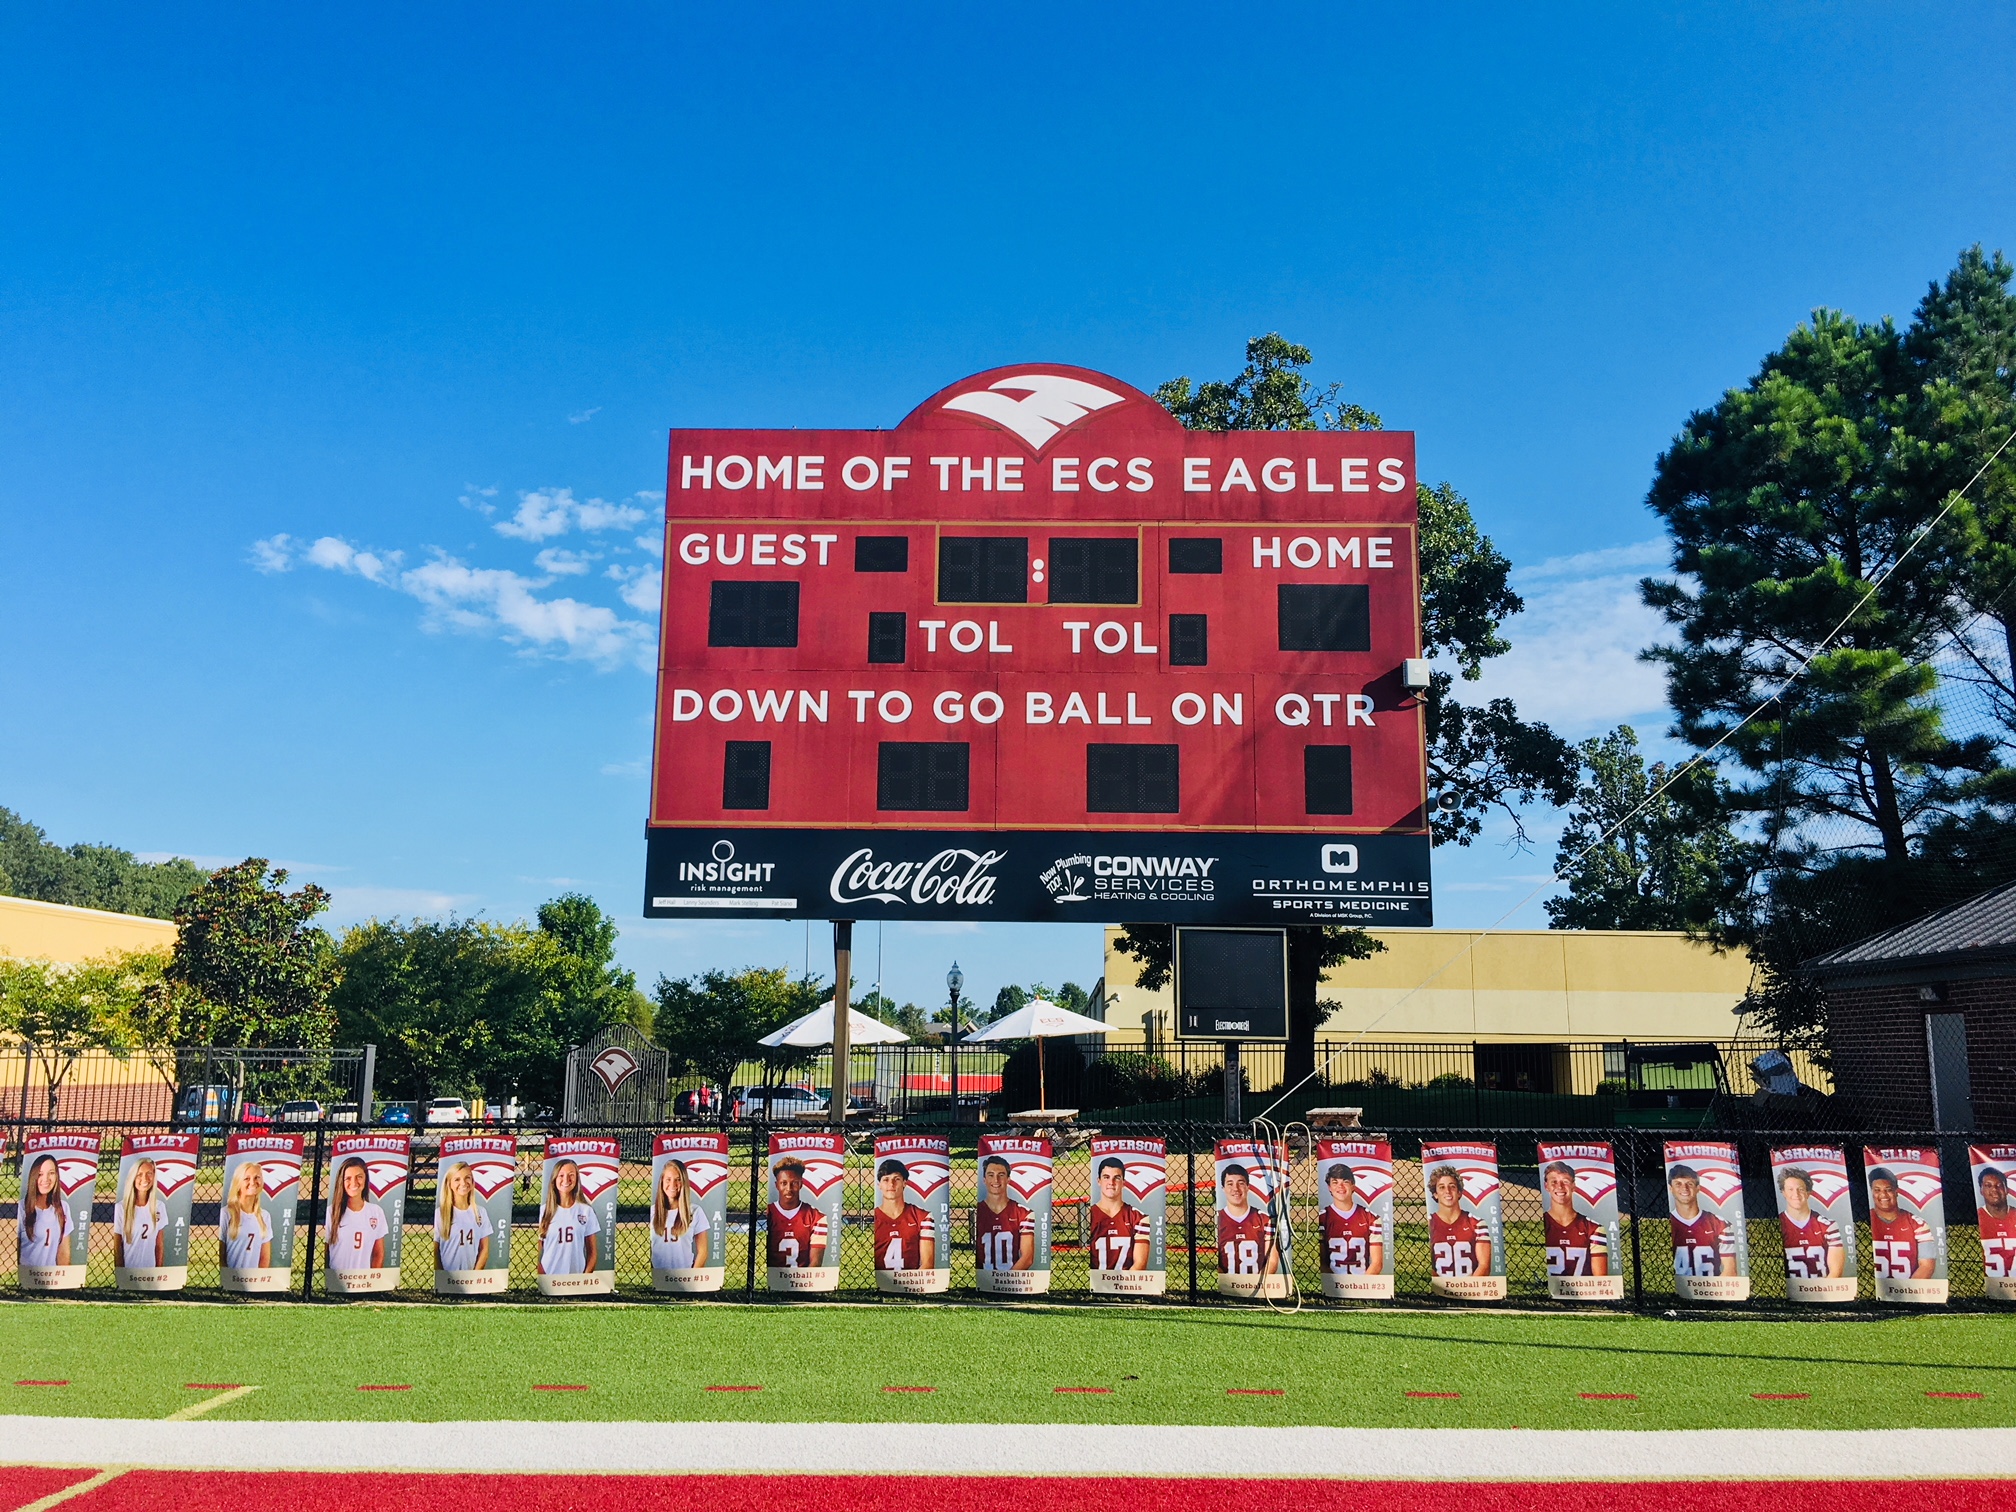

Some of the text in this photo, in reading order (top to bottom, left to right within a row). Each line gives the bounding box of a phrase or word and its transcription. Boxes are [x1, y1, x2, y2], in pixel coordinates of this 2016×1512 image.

[681, 454, 1406, 493] HOME OF THE ECS EAGLES
[679, 533, 838, 566] GUEST
[1252, 537, 1394, 569] HOME
[918, 620, 1013, 653] TOL
[1063, 621, 1158, 654] TOL
[672, 689, 1376, 727] DOWN TO GO BALL ON QTR
[679, 862, 775, 881] INSIGHT
[1039, 853, 1091, 884] Now Plumbing
[1094, 856, 1214, 877] CONWAY
[830, 848, 1008, 905] Coca-Cola
[1094, 878, 1214, 891] SERVICES
[691, 883, 762, 894] risk management
[1253, 880, 1429, 892] ORTHOMEMPHIS
[1273, 900, 1409, 910] SPORTS MEDICINE
[28, 1138, 98, 1150] CARRUTH
[132, 1136, 189, 1148] ELLZEY
[238, 1138, 294, 1150] ROGERS
[337, 1138, 406, 1151] COOLIDGE
[445, 1138, 513, 1152] SHORTEN
[549, 1142, 616, 1154] SOMOGYI
[662, 1137, 718, 1151] ROOKER
[778, 1137, 835, 1149] BROOKS
[876, 1139, 948, 1152] WILLIAMS
[988, 1139, 1042, 1153] WELCH
[1093, 1140, 1164, 1153] EPPERSON
[1332, 1143, 1376, 1155] SMITH
[1423, 1146, 1494, 1158] ROSENBERGER
[1544, 1146, 1607, 1158] BOWDEN
[1881, 1149, 1920, 1161] ELLIS
[44, 1229, 50, 1246] 1
[142, 1224, 148, 1239] 2
[459, 1229, 473, 1246] 14
[558, 1226, 573, 1243] 16
[246, 1233, 254, 1250] 7
[354, 1232, 363, 1249] 9
[778, 1239, 800, 1267] 3
[884, 1238, 904, 1270] 4
[981, 1231, 1013, 1270] 10
[1095, 1237, 1131, 1270] 17
[1224, 1241, 1259, 1274] 18
[1329, 1238, 1366, 1274] 23
[1434, 1242, 1472, 1276] 26
[1547, 1247, 1586, 1276] 27
[1674, 1246, 1714, 1276] 46
[1785, 1249, 1827, 1278] 53
[1874, 1242, 1911, 1278] 55
